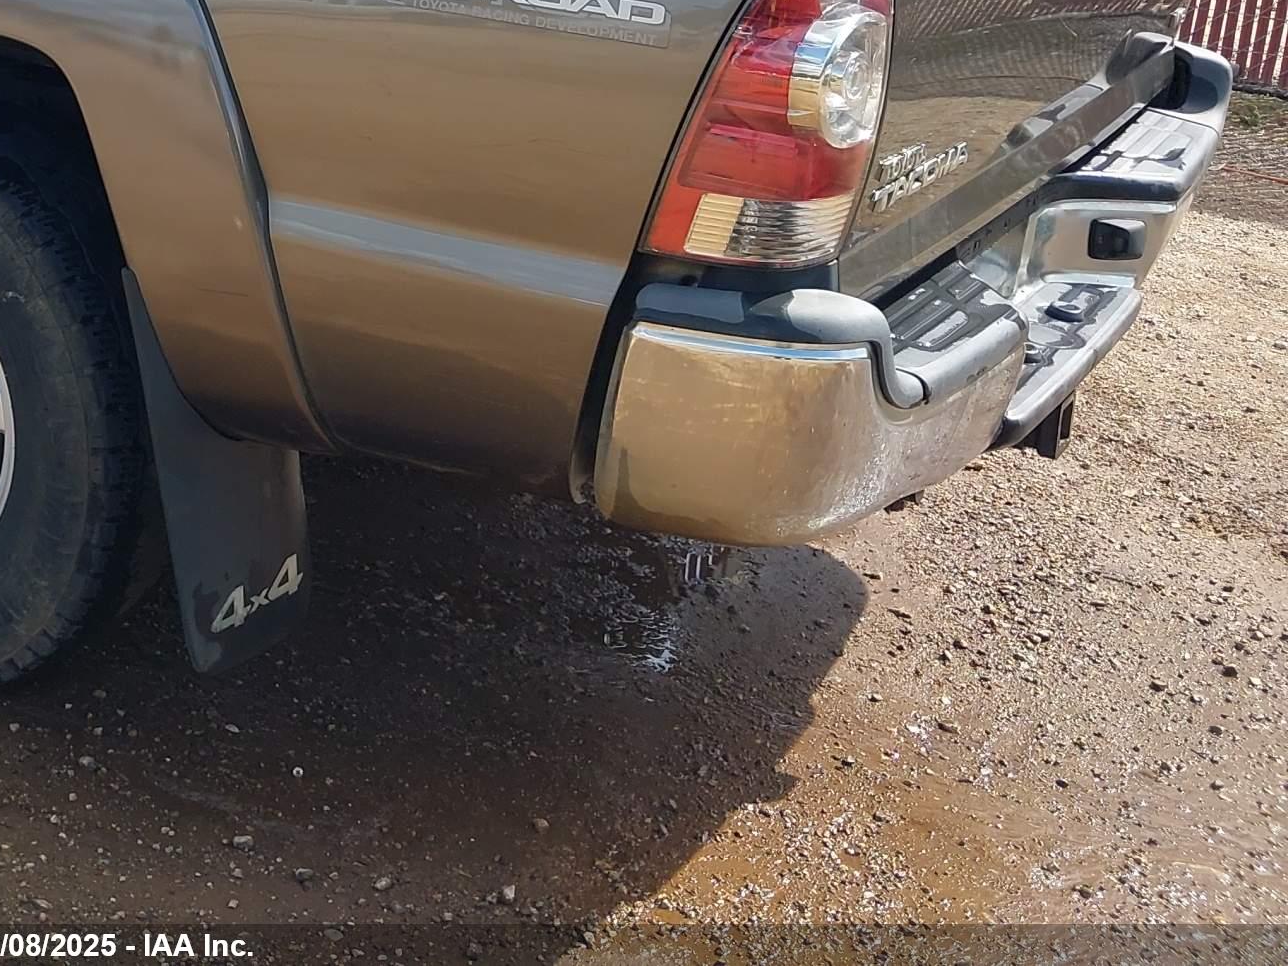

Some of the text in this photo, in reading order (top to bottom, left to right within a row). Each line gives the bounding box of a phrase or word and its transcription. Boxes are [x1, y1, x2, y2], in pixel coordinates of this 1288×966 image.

[471, 5, 530, 27] RACING
[535, 15, 658, 47] DEVELOPMENT
[872, 141, 968, 213] TACOMA
[211, 553, 304, 634] 4x4
